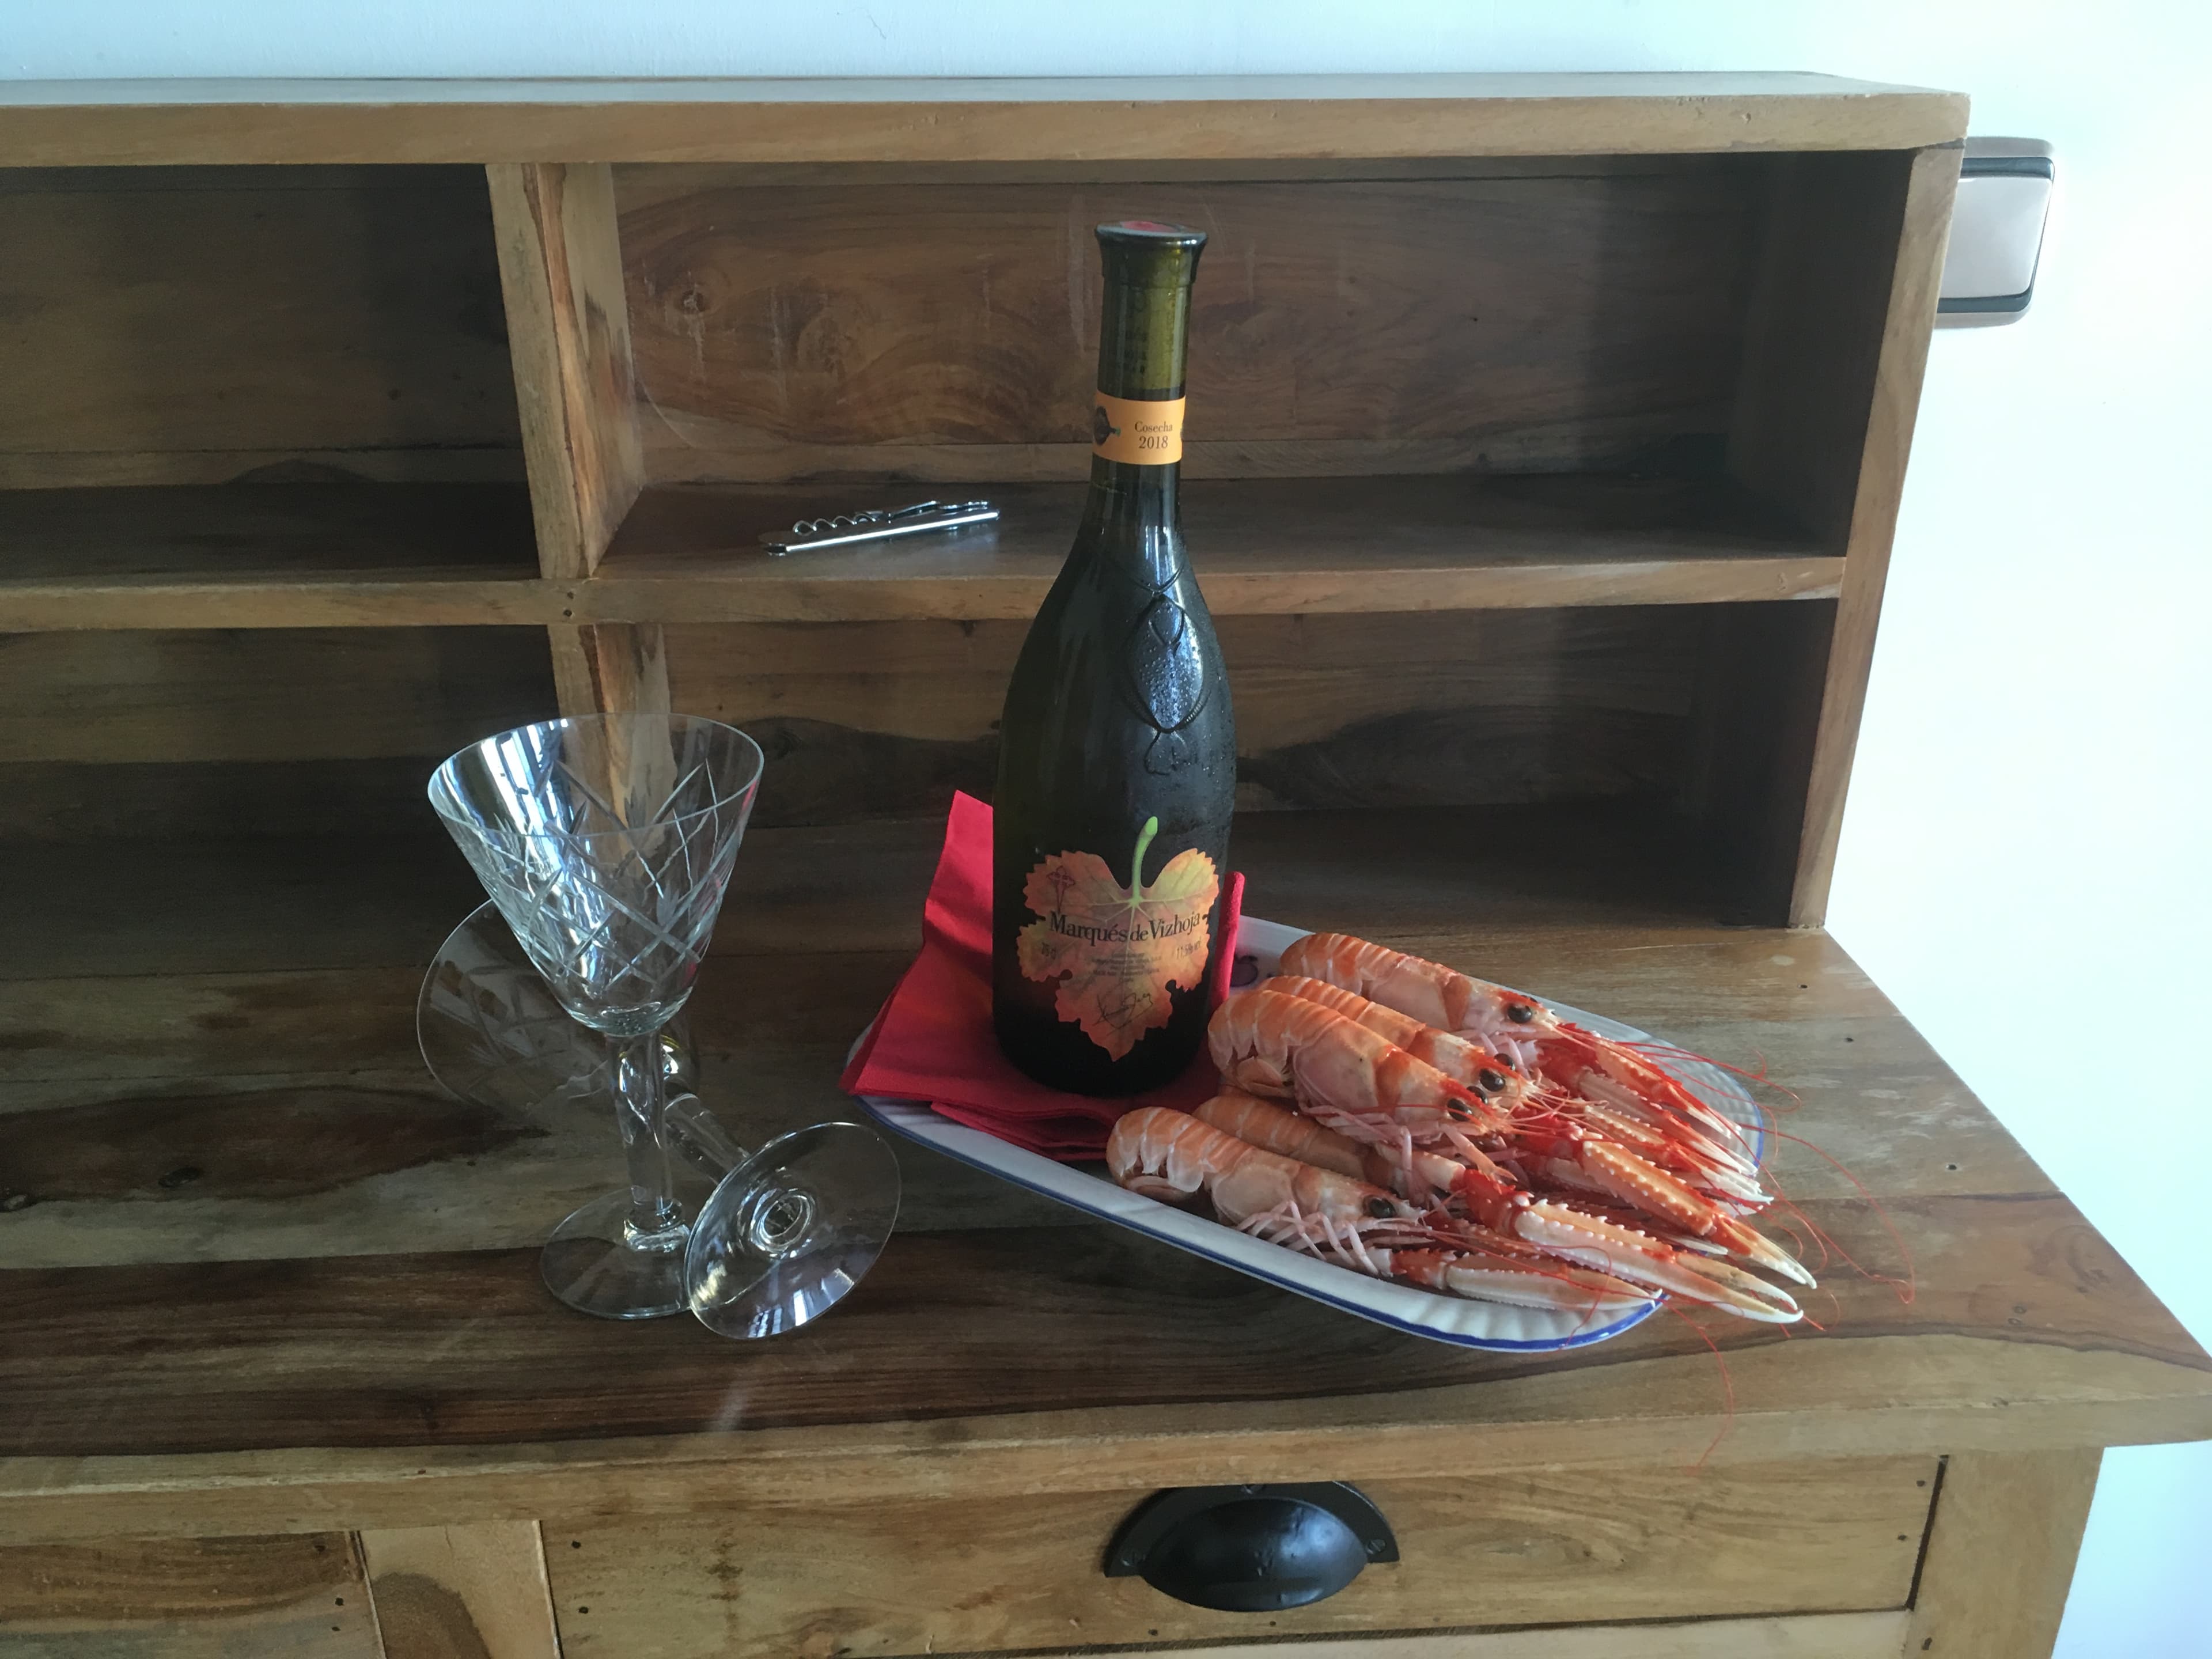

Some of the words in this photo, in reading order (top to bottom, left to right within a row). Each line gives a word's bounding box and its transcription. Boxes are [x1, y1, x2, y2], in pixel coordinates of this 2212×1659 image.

[1135, 421, 1173, 433] Cosecha
[1139, 435, 1168, 449] 2018
[1050, 910, 1127, 946] Marqués
[1130, 924, 1149, 941] de
[1149, 911, 1200, 940] Vizhoja
